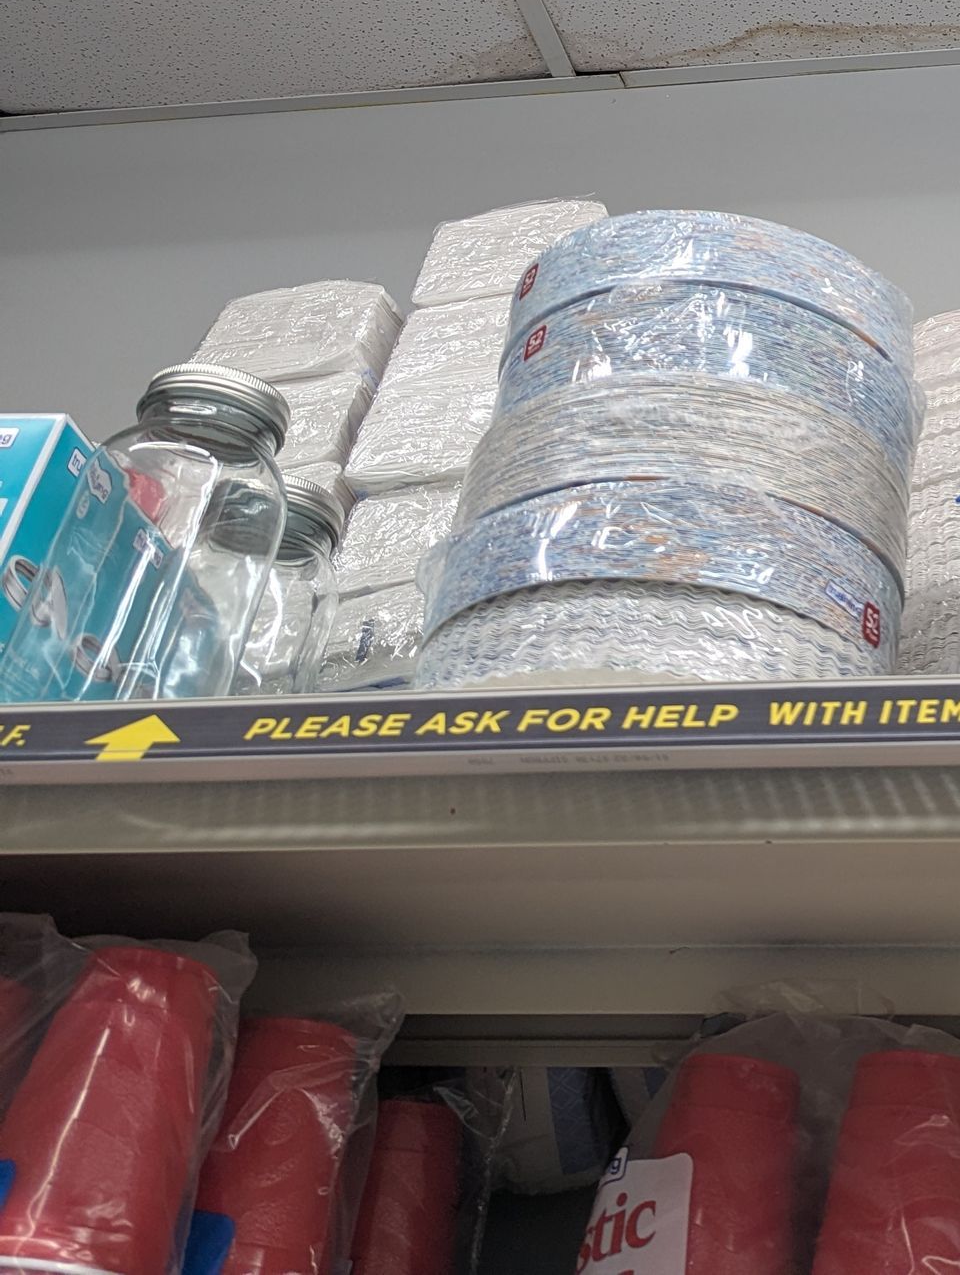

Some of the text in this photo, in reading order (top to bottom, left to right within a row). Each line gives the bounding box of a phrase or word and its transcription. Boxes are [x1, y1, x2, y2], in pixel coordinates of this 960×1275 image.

[243, 712, 412, 742] PLEASE
[415, 710, 511, 736] ASK
[516, 707, 613, 733] FOR
[621, 703, 740, 731] HELP
[768, 699, 867, 727] WITH
